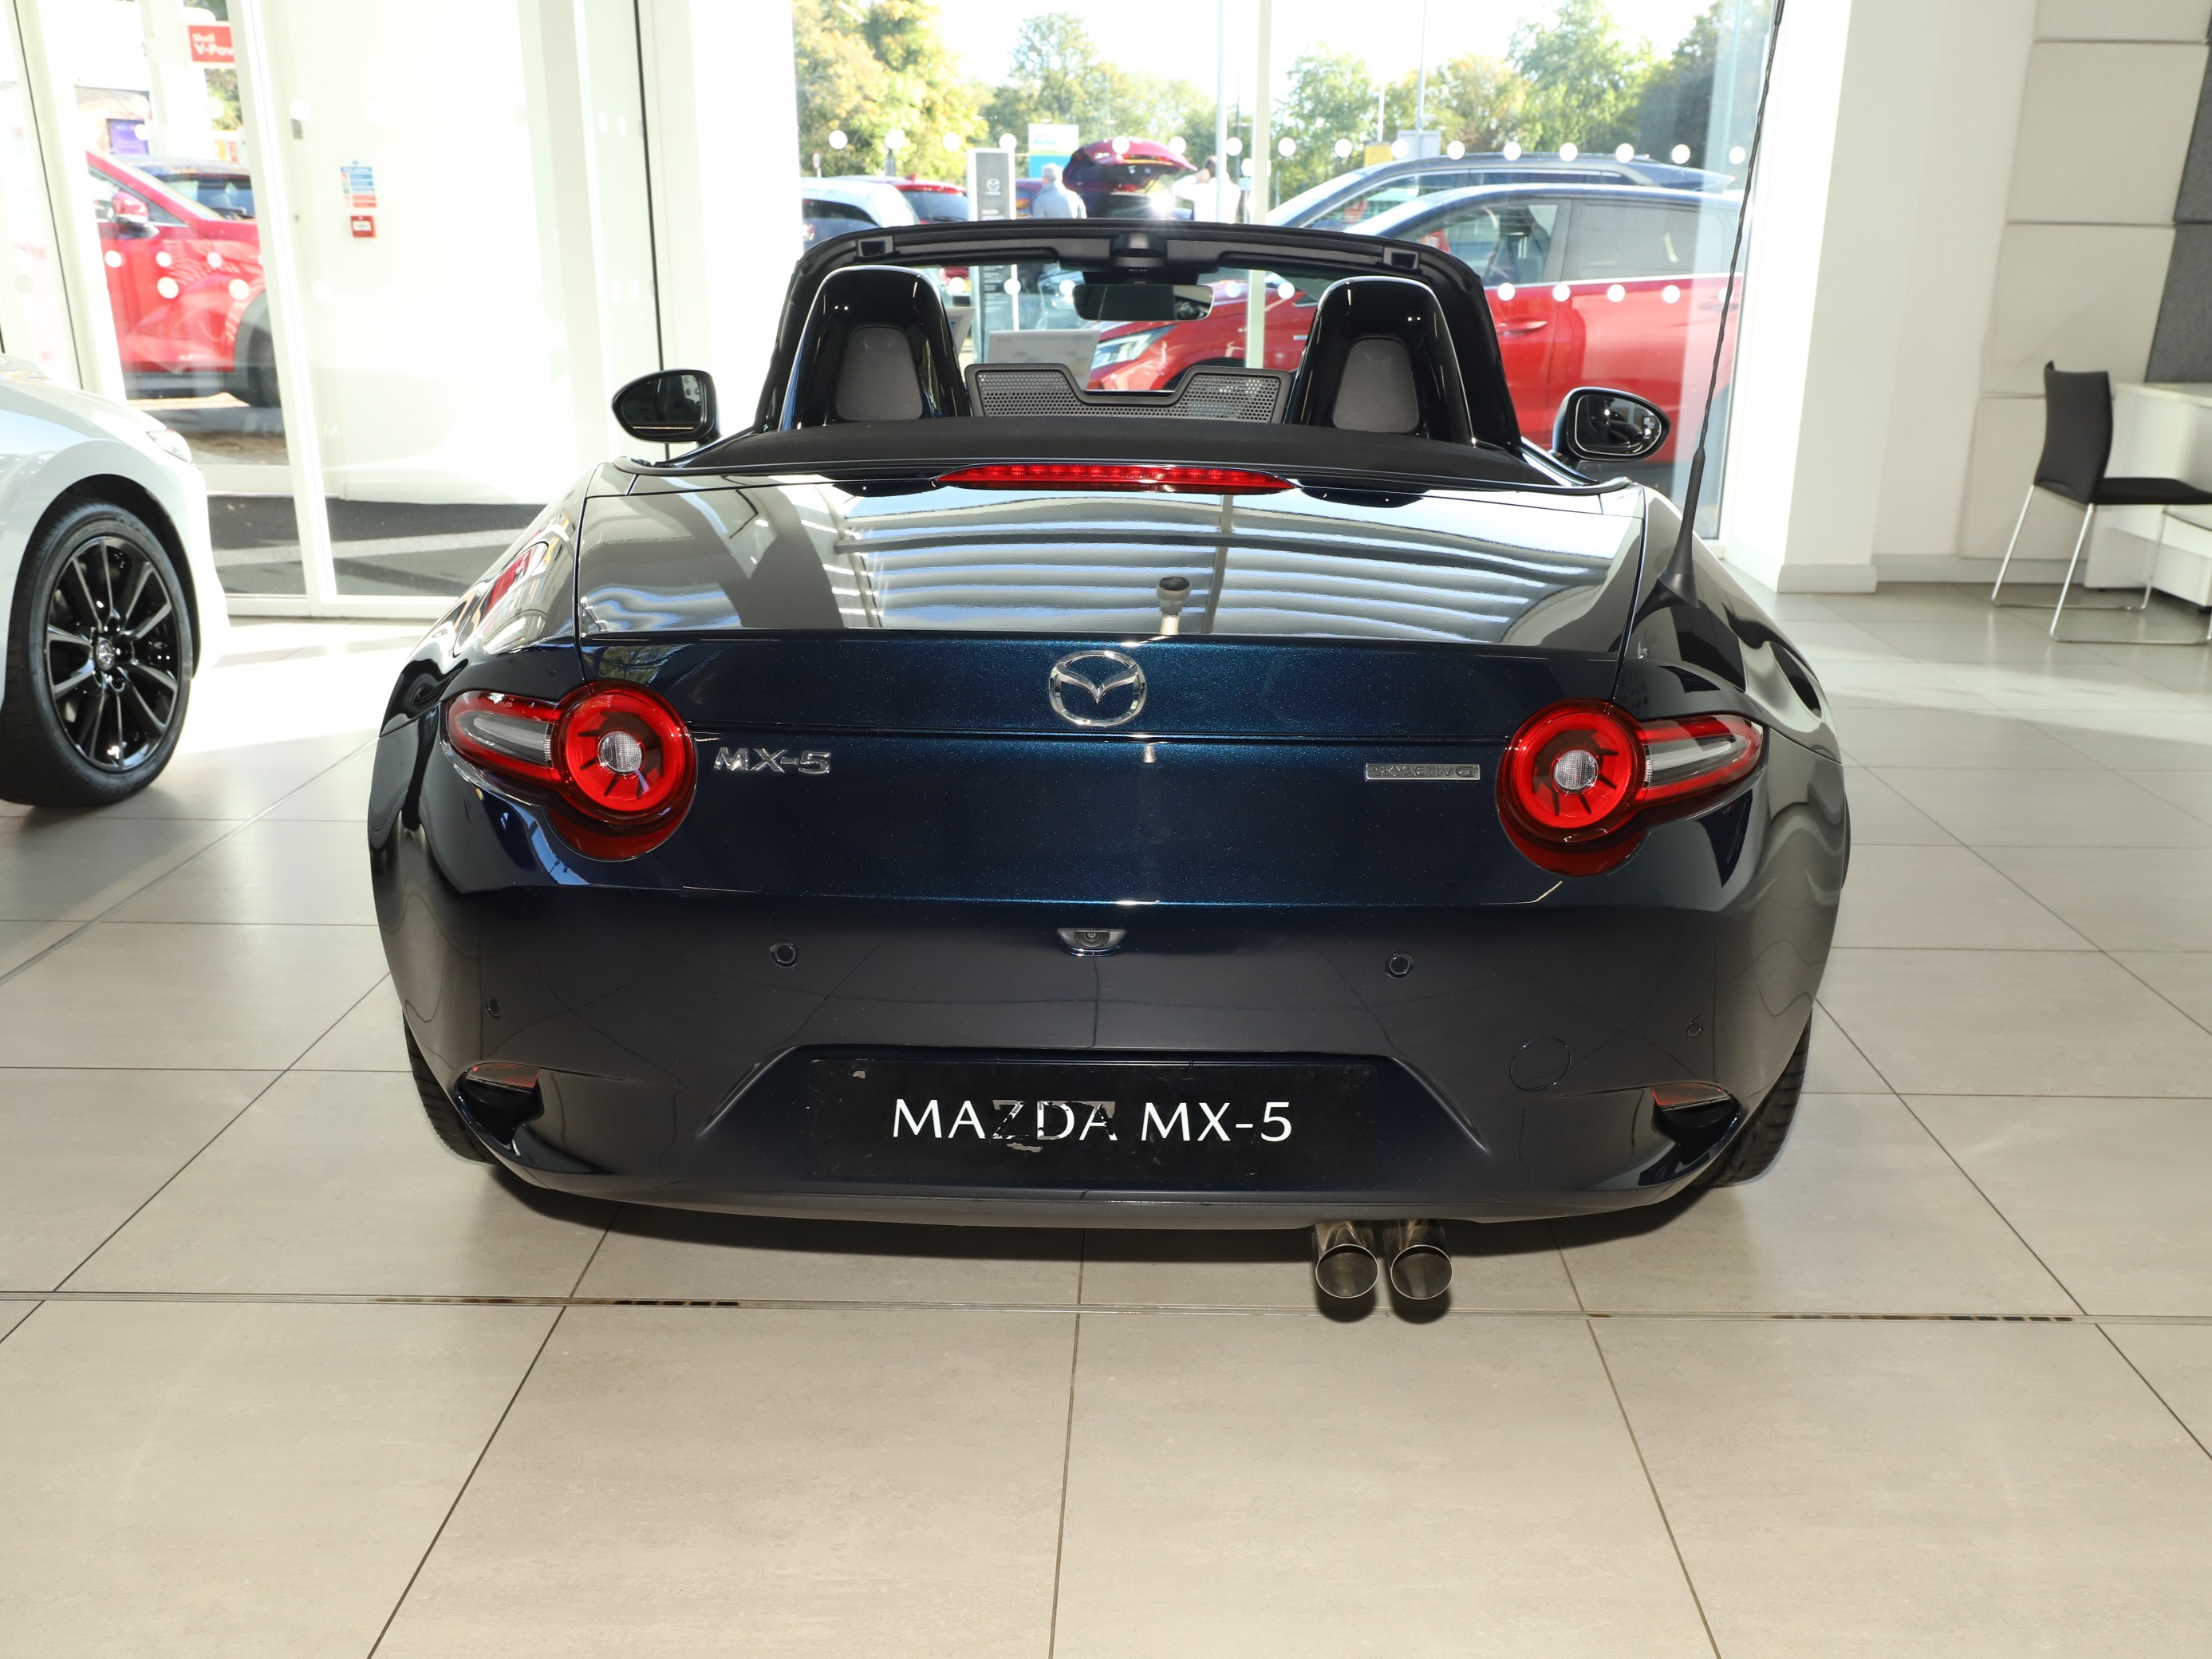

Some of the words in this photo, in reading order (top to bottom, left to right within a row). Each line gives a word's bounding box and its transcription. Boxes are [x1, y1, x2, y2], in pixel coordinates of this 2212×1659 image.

[714, 747, 832, 774] MX-5
[1372, 765, 1451, 778] SKYACTIV
[893, 1098, 1118, 1141] MAZDA
[1141, 1101, 1292, 1142] MX-5
